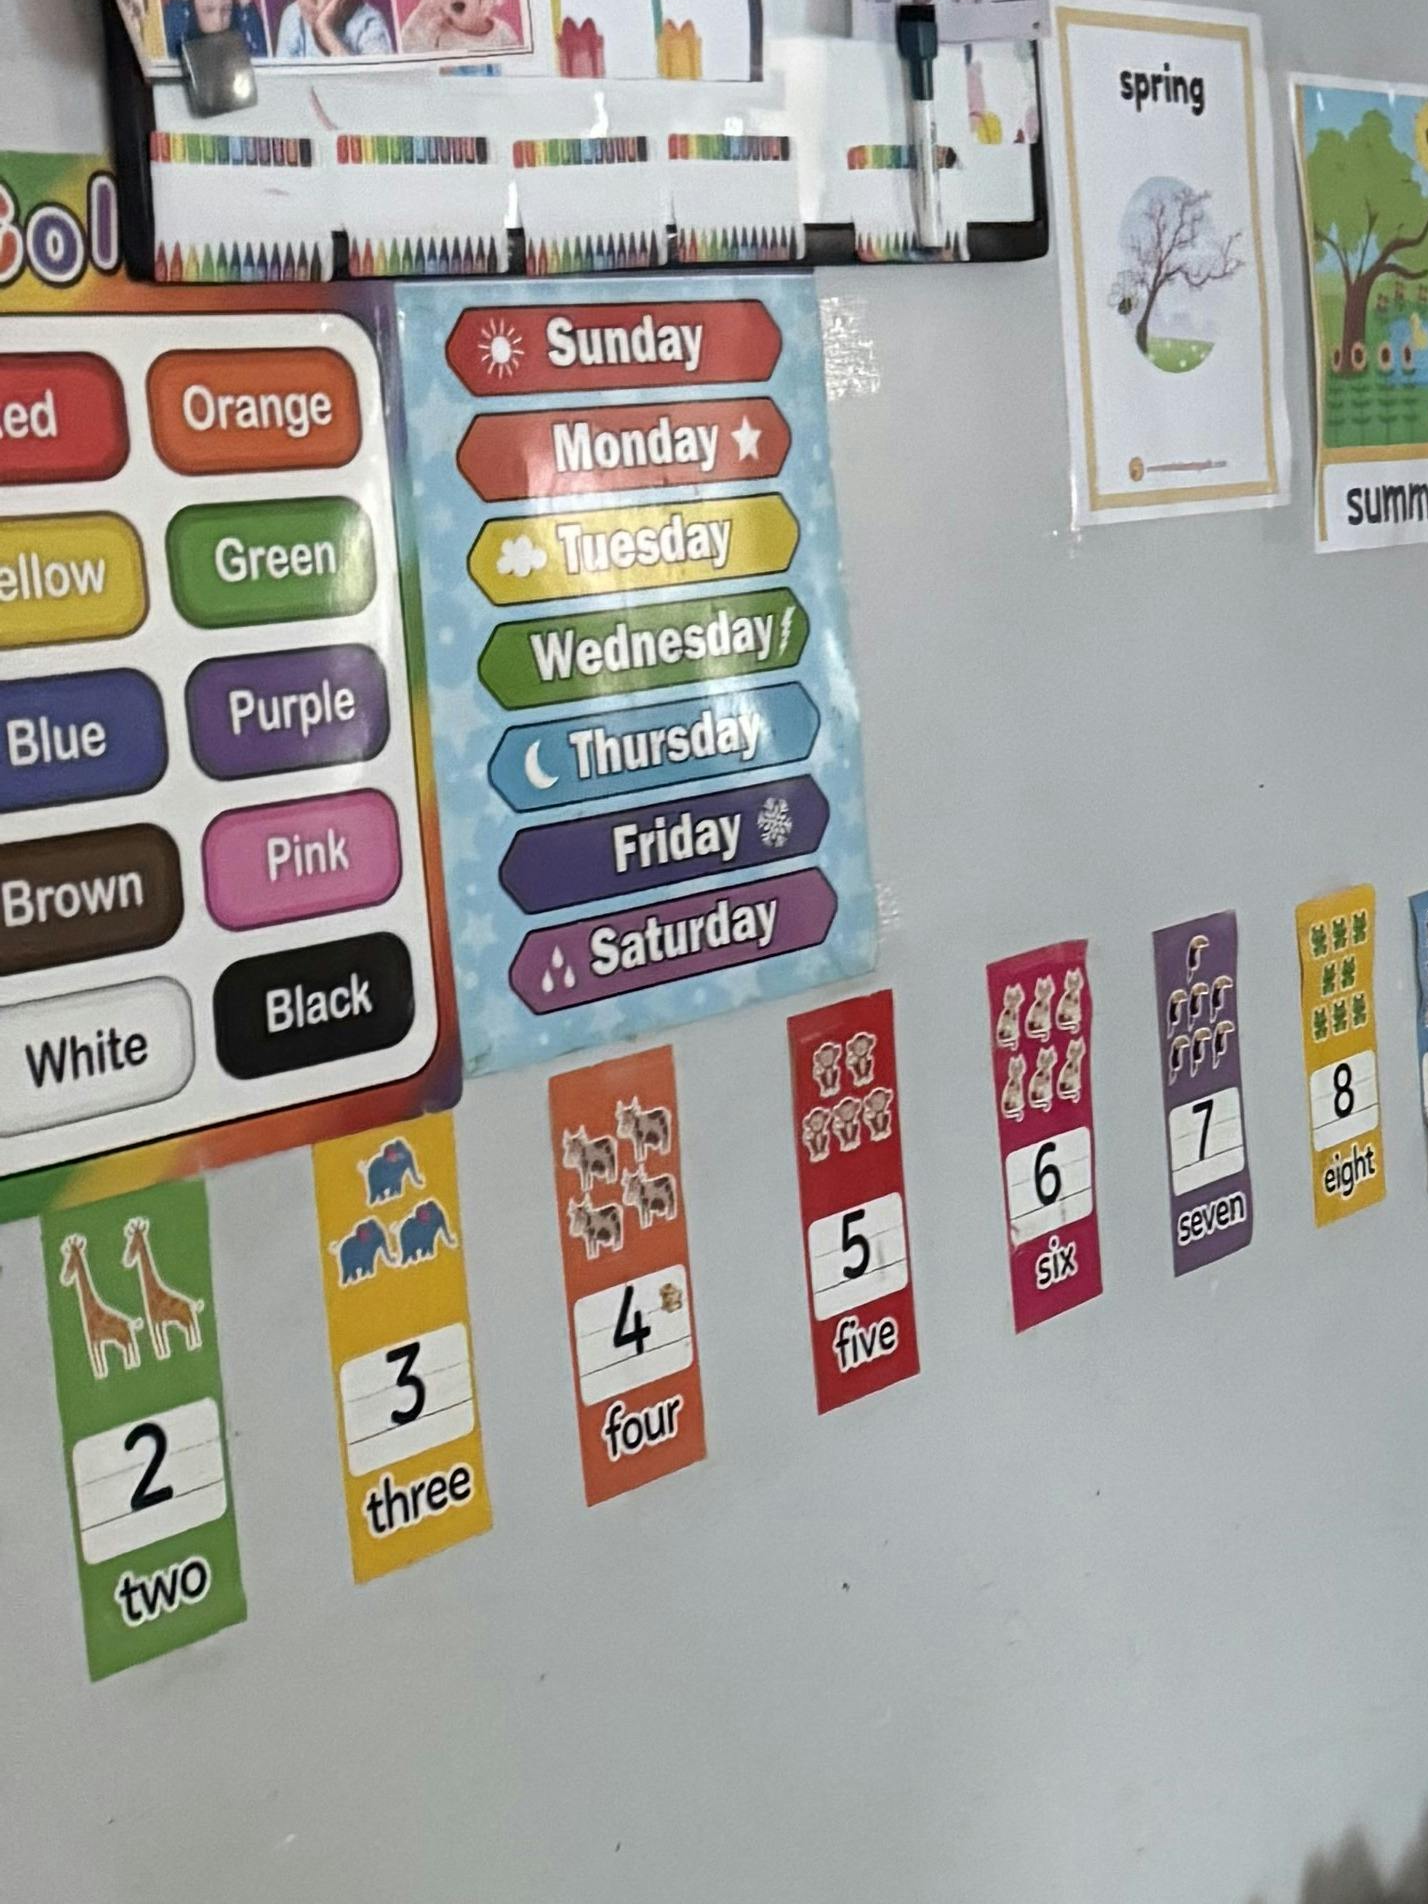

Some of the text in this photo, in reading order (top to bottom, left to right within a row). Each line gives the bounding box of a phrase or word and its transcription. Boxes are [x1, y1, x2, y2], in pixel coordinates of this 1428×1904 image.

[1119, 62, 1205, 116] spring
[546, 314, 704, 372] Sunday
[0, 388, 58, 439] ed
[182, 384, 333, 439] Orange
[551, 417, 720, 477] Monday
[214, 537, 337, 583] Green
[556, 518, 734, 578] Tuesday
[529, 609, 776, 684] Wednesday
[228, 677, 356, 739] Purple
[6, 718, 107, 767] Blue
[568, 704, 763, 783] Thursday
[266, 827, 350, 883] Pink
[612, 809, 743, 876] Friday
[1, 870, 144, 928] Brown
[588, 894, 780, 978] Saturday
[265, 972, 375, 1035] Black
[25, 1027, 149, 1089] White
[1333, 1062, 1354, 1119] 8
[1192, 1099, 1214, 1161] 7
[1034, 1141, 1062, 1205] 6
[1325, 1145, 1376, 1197] eight
[841, 1208, 870, 1279] 5
[1178, 1195, 1245, 1243] seven
[1037, 1236, 1077, 1288] six
[612, 1286, 651, 1355] 4
[834, 1320, 897, 1372] five
[385, 1341, 426, 1425] 3
[602, 1396, 681, 1459] four
[123, 1421, 175, 1514] 2
[365, 1465, 472, 1536] three
[118, 1559, 208, 1621] two
